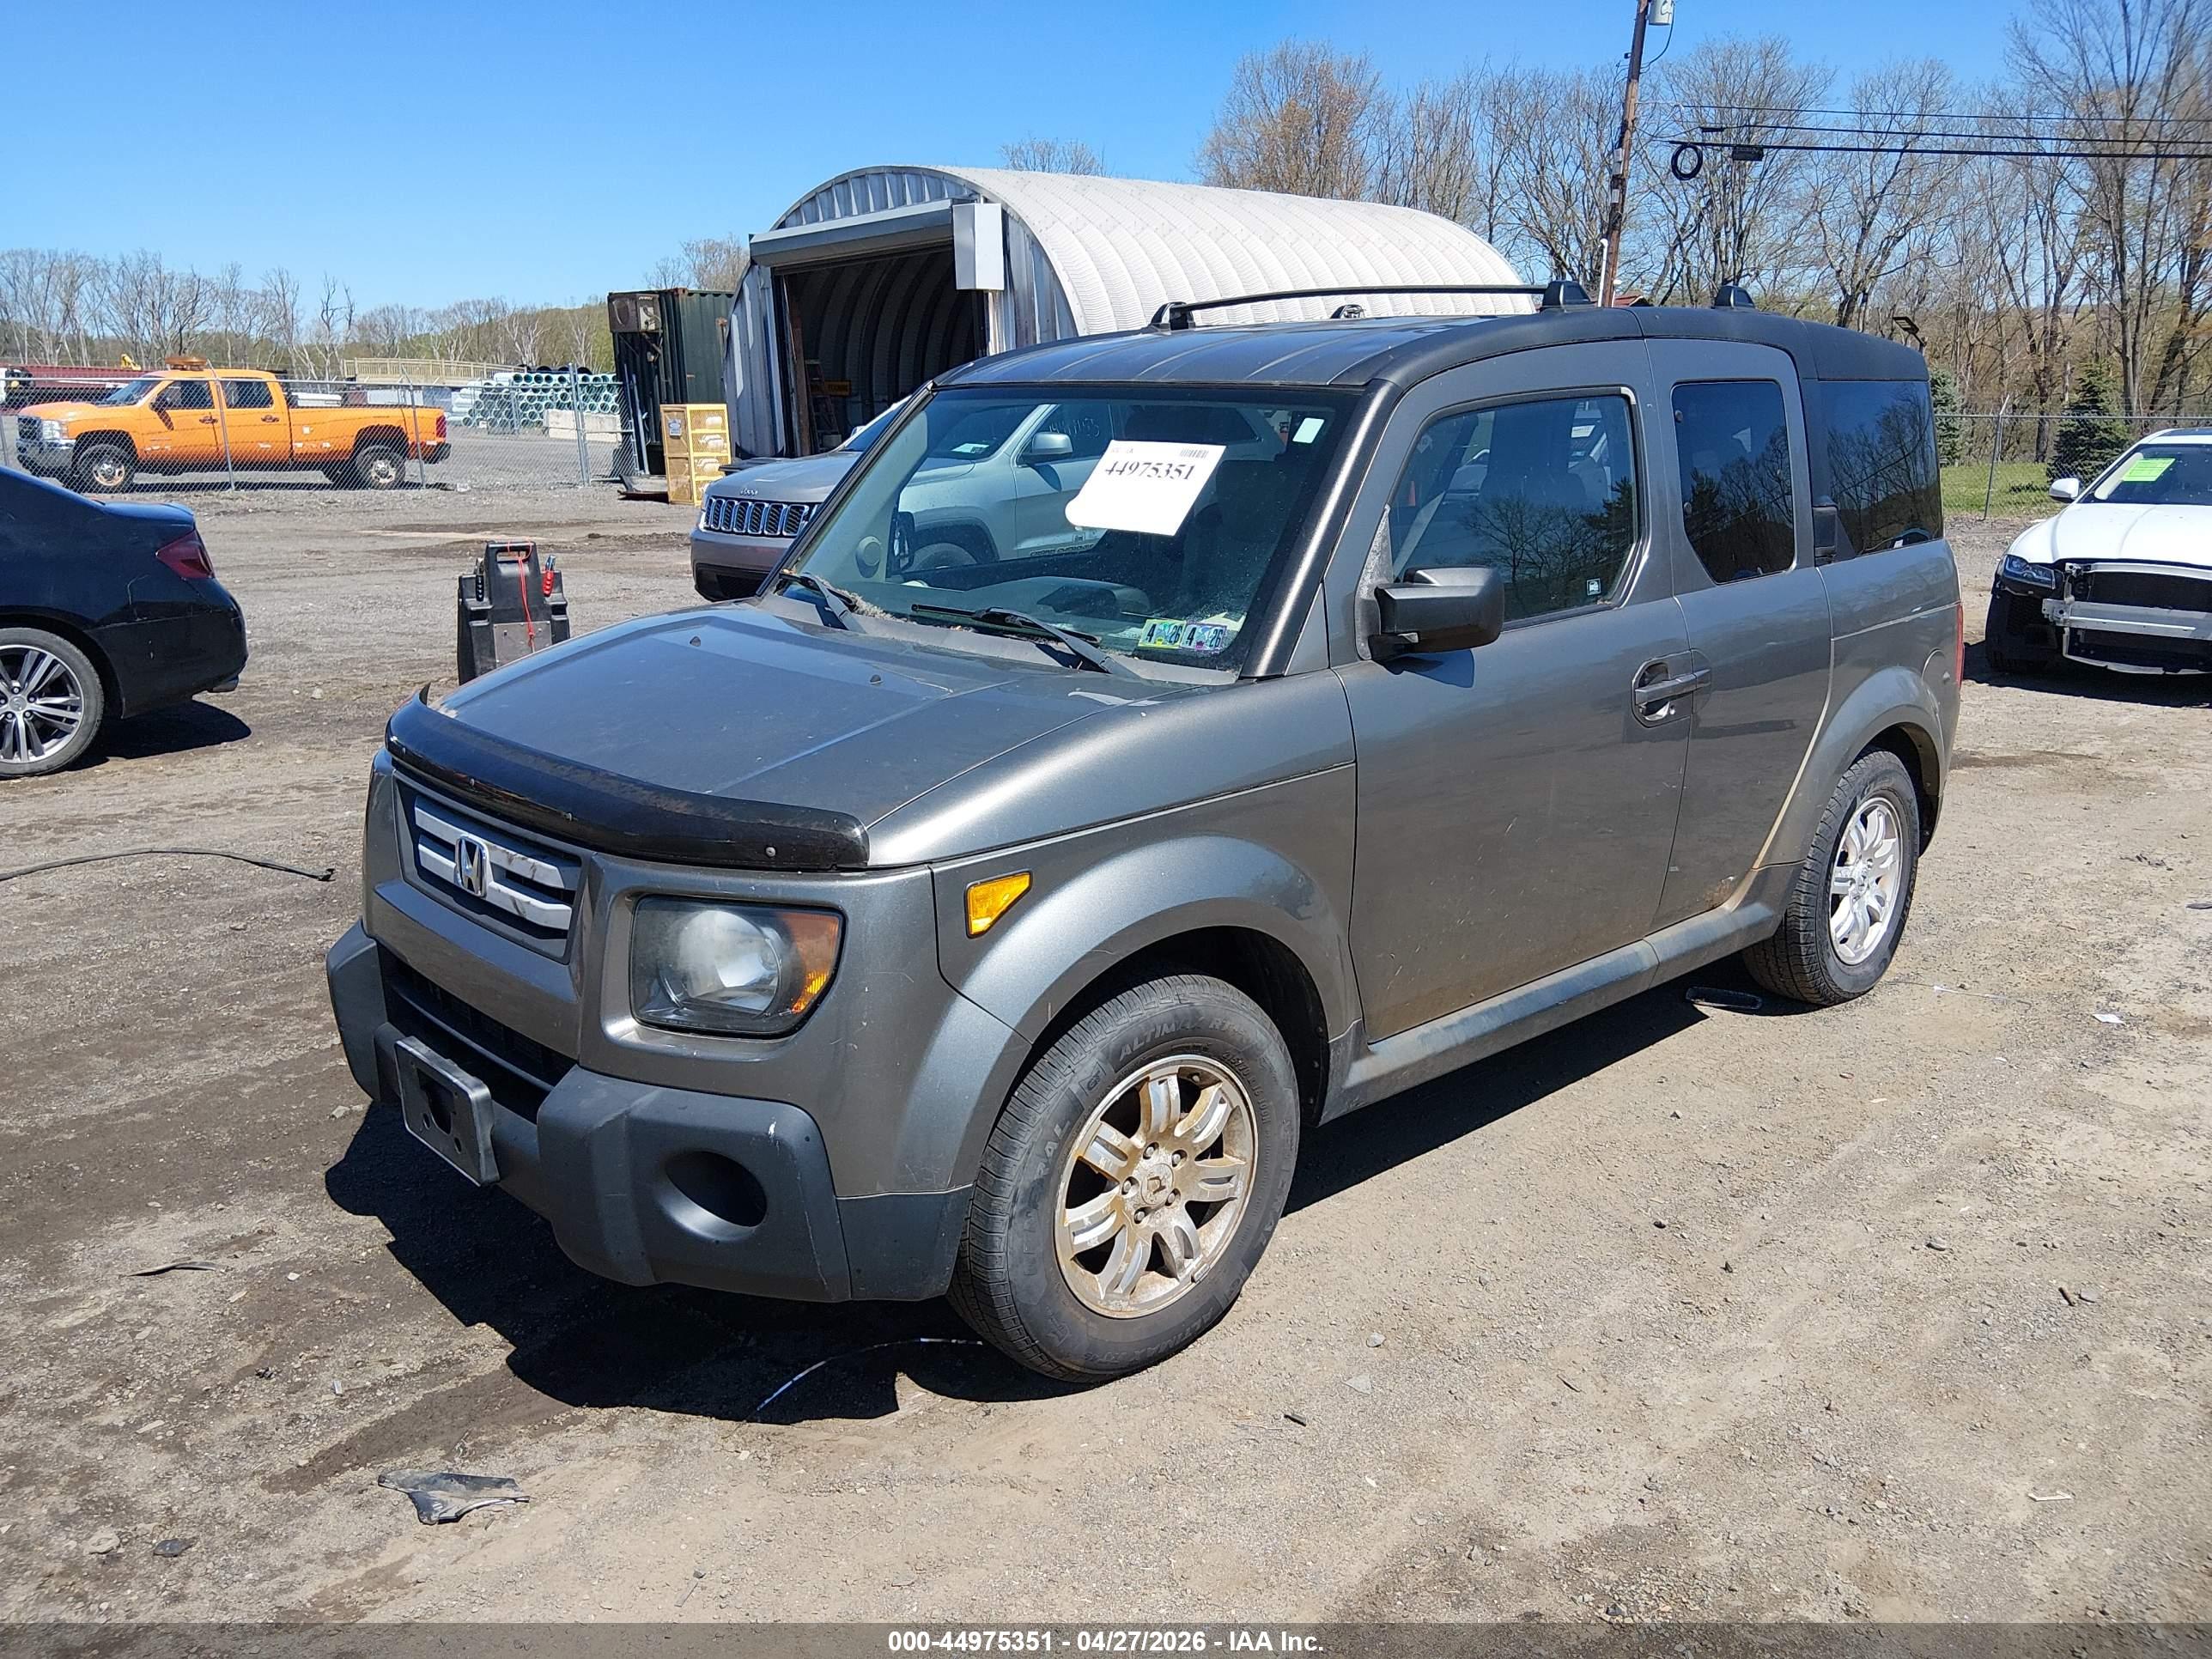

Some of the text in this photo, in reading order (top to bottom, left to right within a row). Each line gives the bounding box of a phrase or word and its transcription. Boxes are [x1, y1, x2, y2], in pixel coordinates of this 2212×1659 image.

[1105, 460, 1195, 480] 44975351
[1146, 623, 1182, 644] 4 26
[1186, 627, 1224, 647] 4 26
